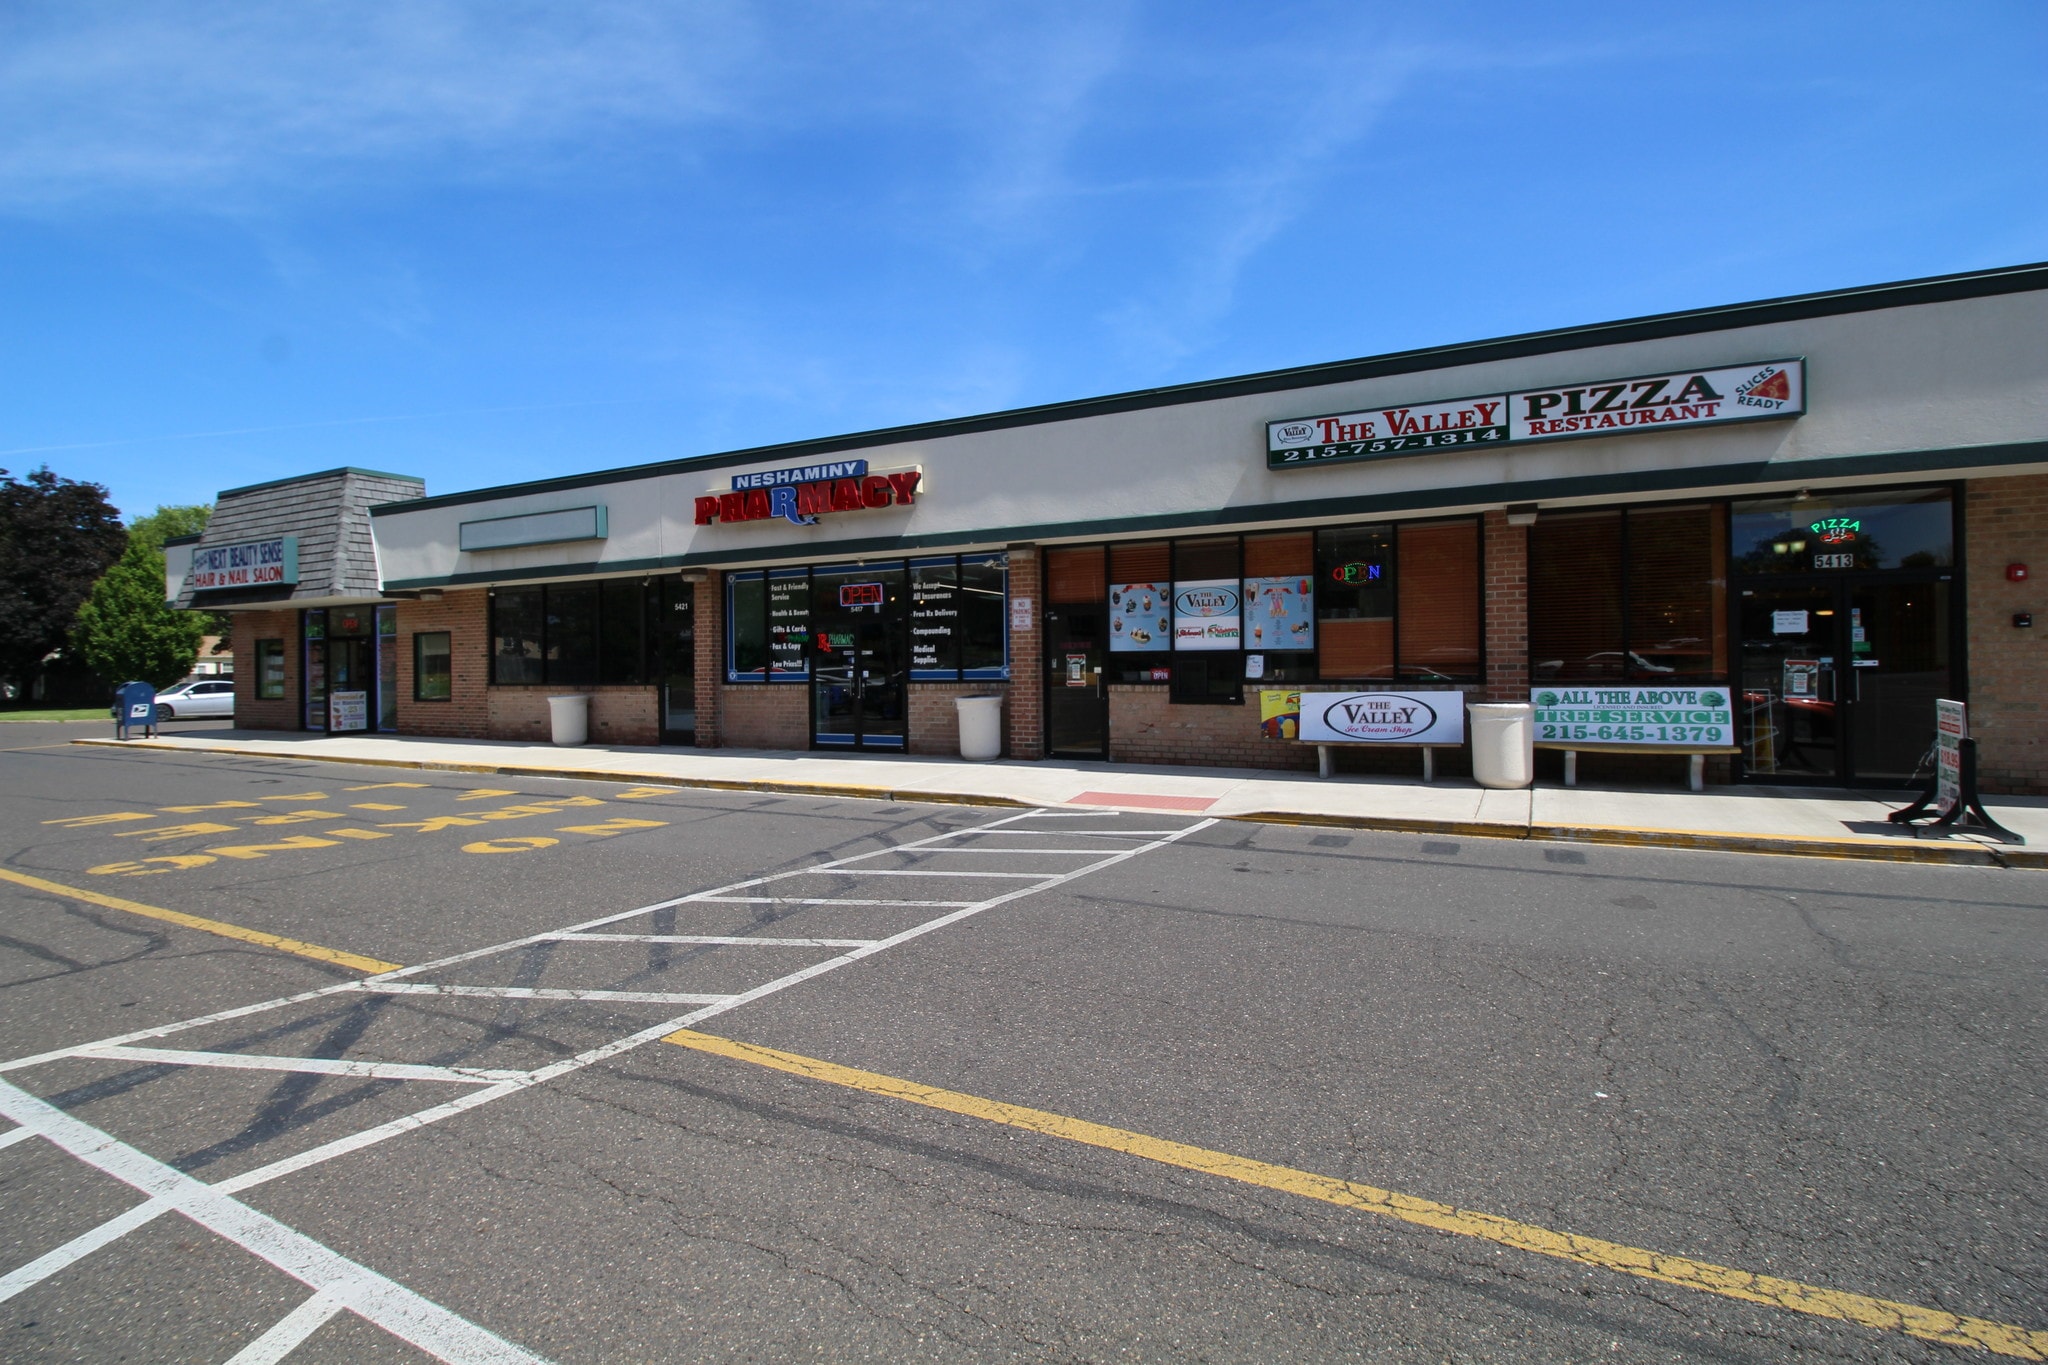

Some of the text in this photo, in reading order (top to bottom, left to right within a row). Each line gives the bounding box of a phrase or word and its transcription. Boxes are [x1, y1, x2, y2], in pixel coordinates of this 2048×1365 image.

[1735, 366, 1775, 396] SLICES
[1523, 375, 1724, 421] PIZZA
[1736, 396, 1784, 410] READY
[1316, 401, 1501, 444] THE VALLEY
[1528, 401, 1721, 436] RESTAURANT
[1283, 429, 1502, 462] 215-757-1314
[736, 461, 859, 489] NESHAMINY
[694, 471, 922, 526] PHARMACY
[1811, 518, 1861, 534] PIZZA
[207, 548, 227, 570] NEXT
[229, 544, 258, 568] BEAUTY
[260, 540, 283, 564] SENSE
[1815, 554, 1852, 567] 5413
[195, 565, 283, 588] HAIR & NAIL SALON
[1332, 565, 1380, 581] OPEN
[771, 584, 782, 592] Fast
[788, 582, 809, 591] Friendly
[771, 593, 790, 601] Service
[841, 586, 882, 604] OPEN
[1186, 594, 1228, 608] VALLEY
[674, 602, 688, 611] 5421
[772, 609, 788, 617] Health
[913, 610, 925, 618] Free
[934, 608, 957, 618] Delivery
[772, 625, 785, 634] Gifts
[791, 624, 807, 633] Cards
[913, 626, 951, 636] Compounding
[829, 633, 855, 645] PHARMAC
[772, 643, 782, 651] Fax
[788, 642, 802, 651] Copy
[913, 644, 936, 653] Medical
[772, 660, 781, 668] Low
[913, 655, 937, 665] Supplies
[1560, 690, 1698, 705] ALL THE ABOVE
[1367, 701, 1391, 710] THE
[1342, 704, 1418, 724] VALLEY
[1537, 710, 1726, 724] TREE SERVICE
[1345, 724, 1413, 735] Ice Cream Shop
[1542, 724, 1722, 742] 215-645-1379
